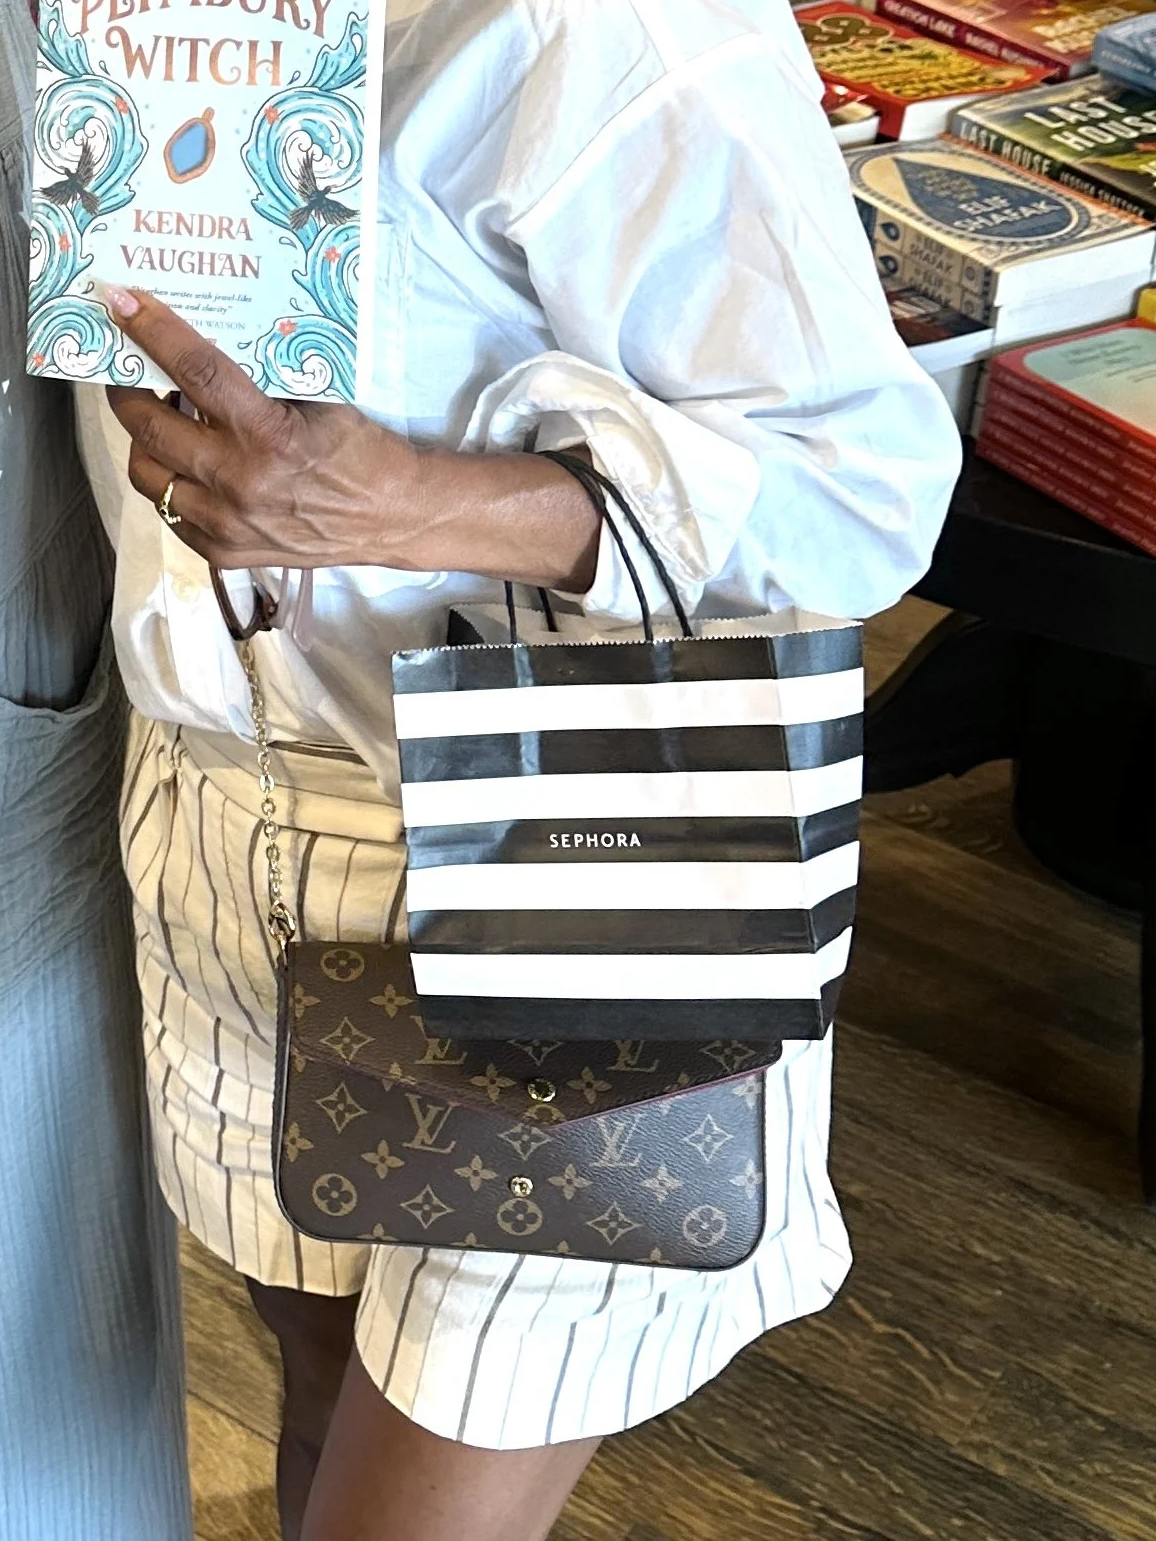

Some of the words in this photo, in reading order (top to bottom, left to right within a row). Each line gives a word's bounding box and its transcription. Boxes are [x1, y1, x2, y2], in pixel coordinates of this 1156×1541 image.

[104, 25, 284, 87] WITCH
[1024, 95, 1127, 129] LAST
[959, 121, 997, 153] LAST
[1000, 138, 1053, 176] HOUSE
[953, 200, 1064, 233] SHAFAK
[958, 194, 1011, 216] ELIF
[132, 209, 255, 241] KENDRA
[119, 244, 263, 280] VAUGHAN
[184, 303, 201, 312] and
[205, 319, 247, 331] WATSON
[549, 832, 643, 850] SEPHORA
